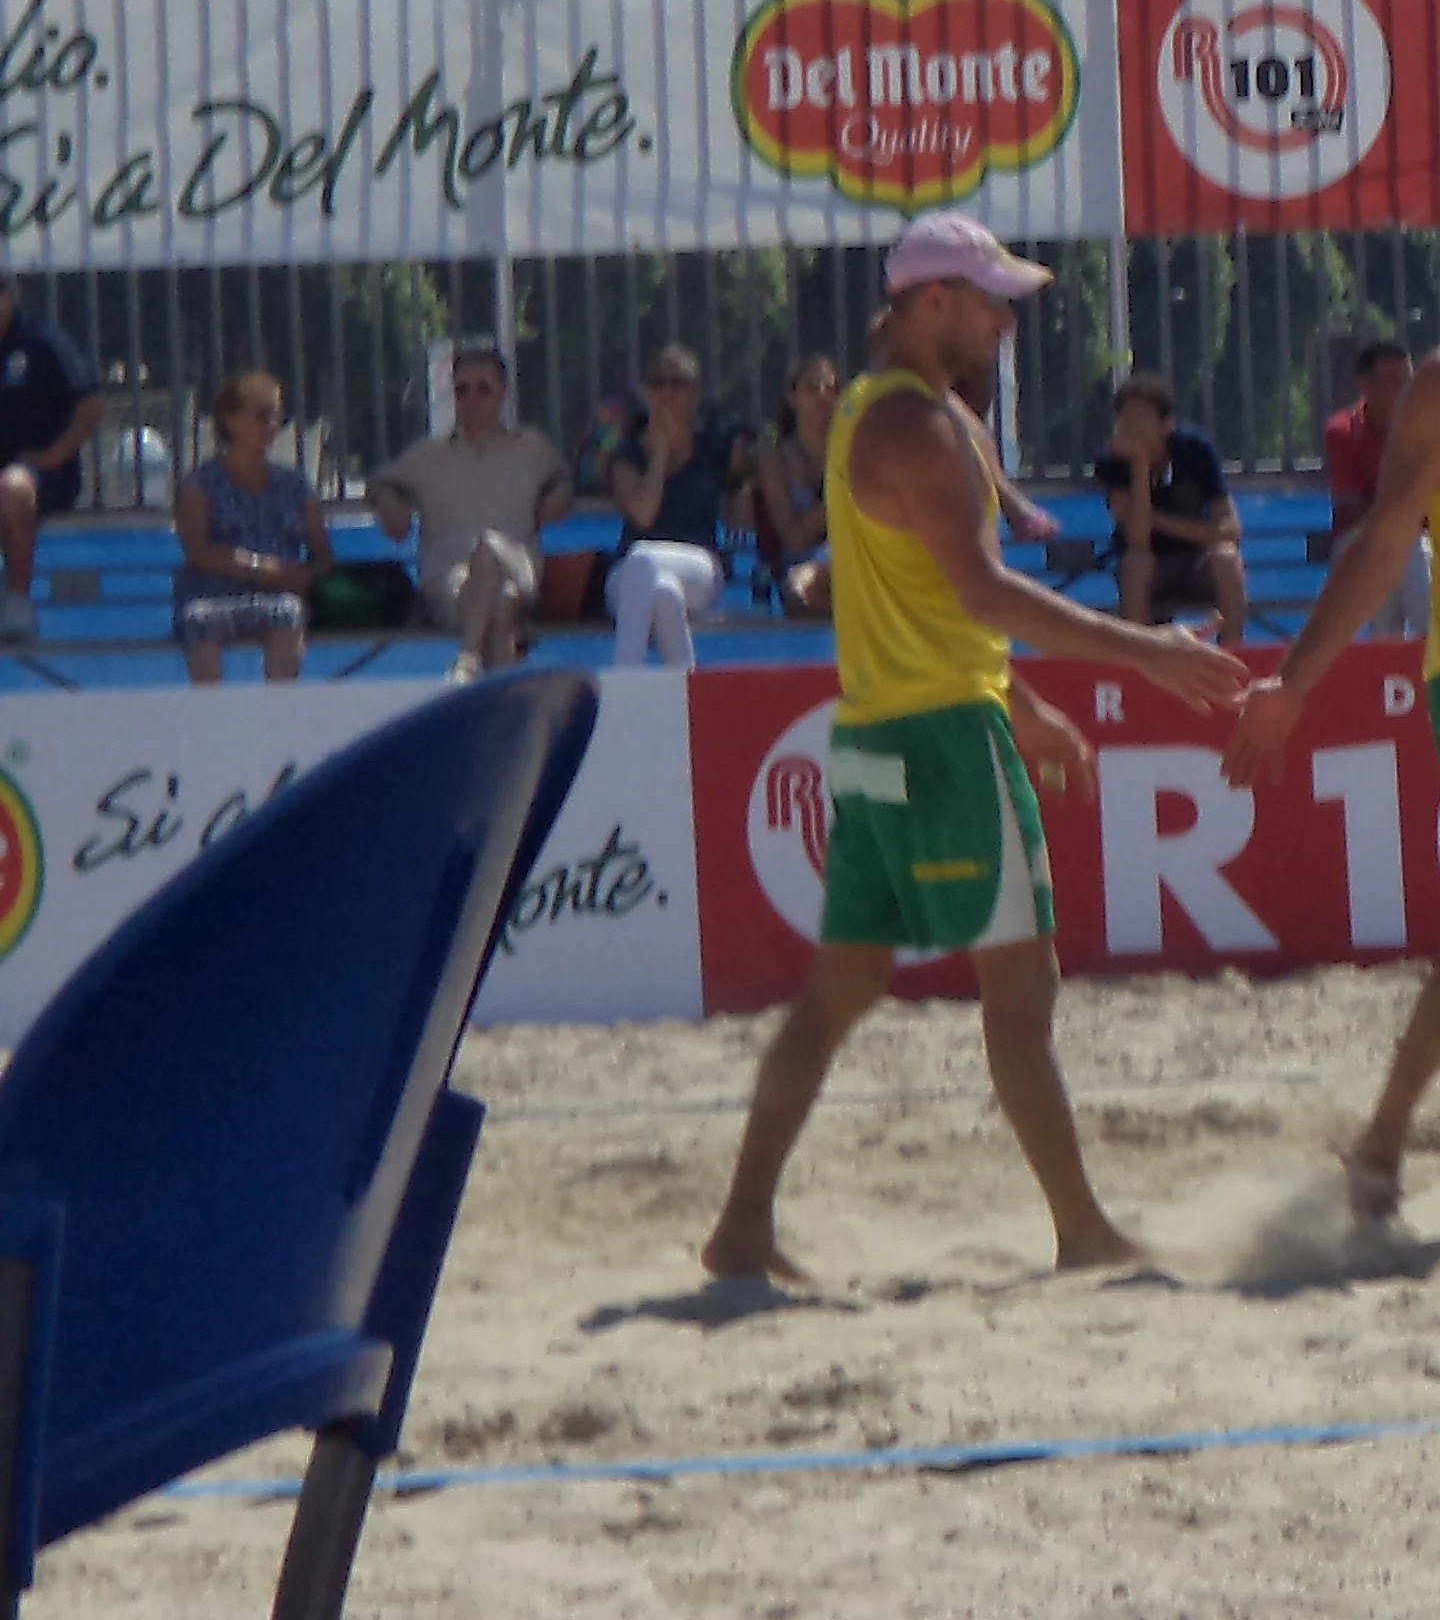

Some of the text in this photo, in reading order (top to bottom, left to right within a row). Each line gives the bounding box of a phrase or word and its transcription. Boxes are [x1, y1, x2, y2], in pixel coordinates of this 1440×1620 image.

[764, 40, 1051, 112] Del Monte
[1229, 57, 1315, 100] 101
[840, 115, 974, 166] Quality
[94, 151, 162, 227] a
[502, 824, 669, 956] onte.
